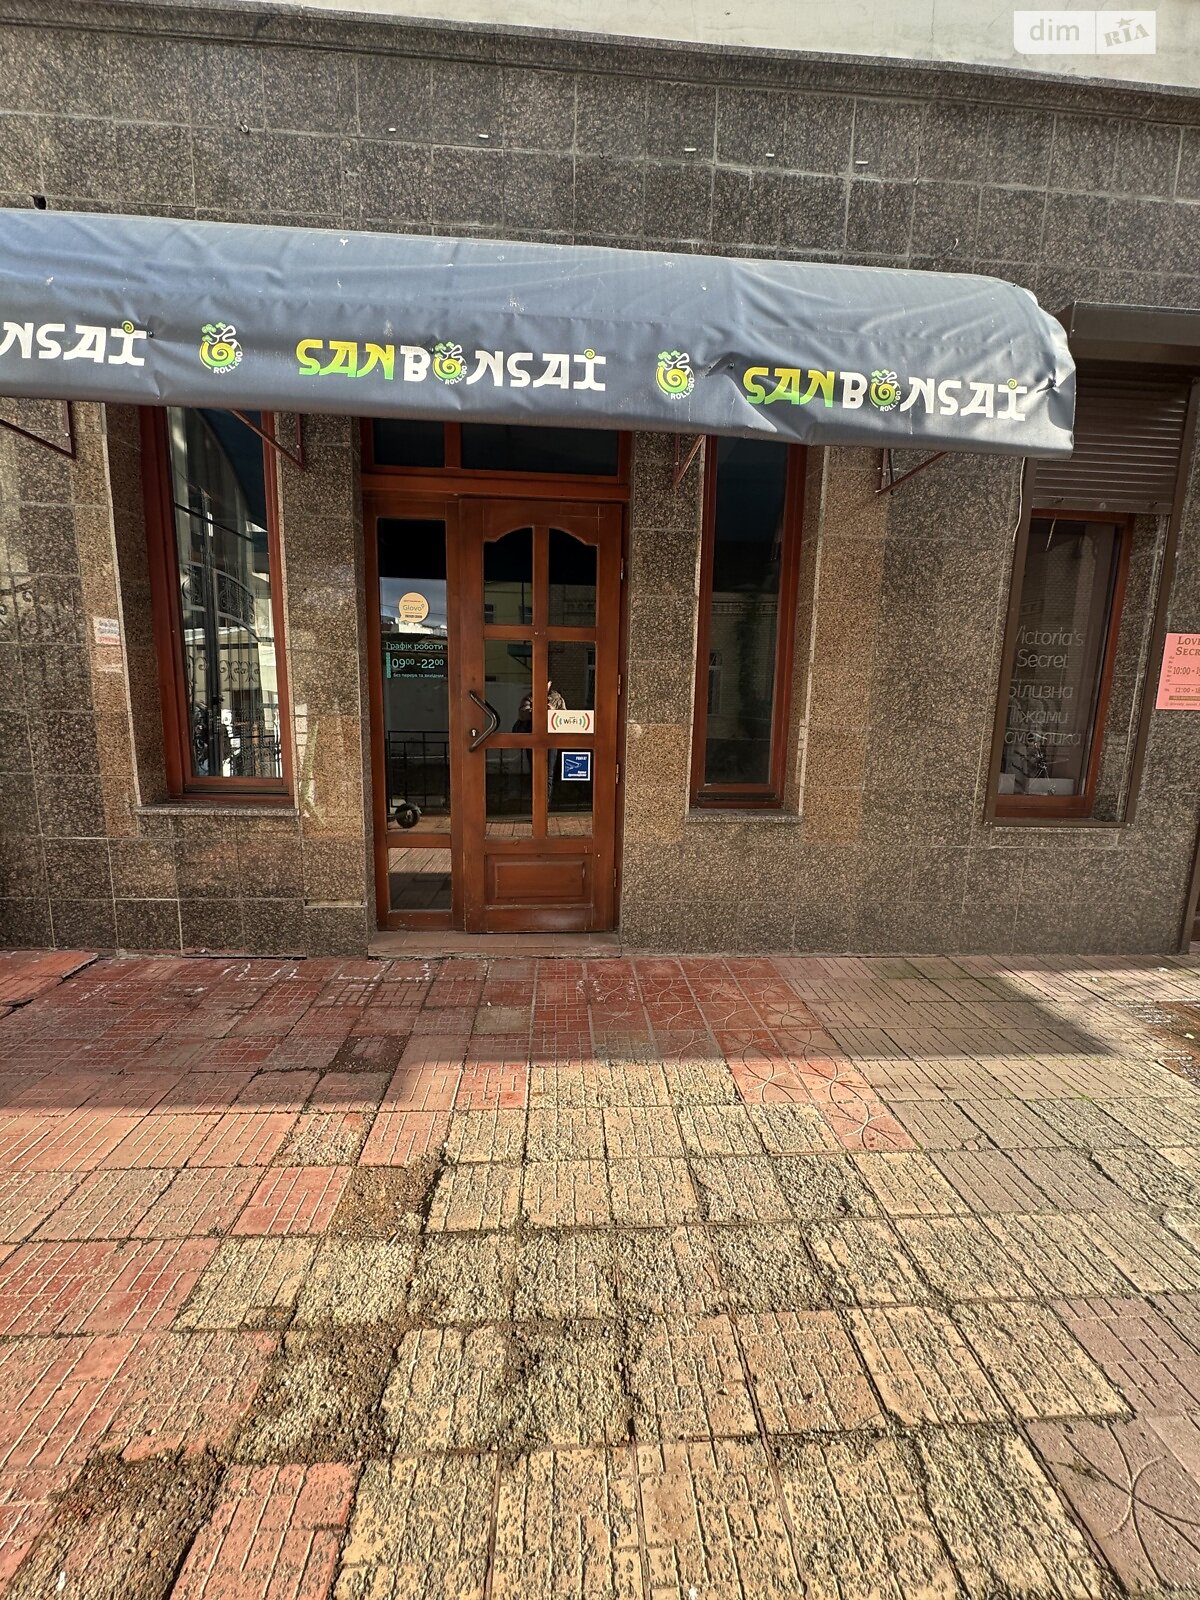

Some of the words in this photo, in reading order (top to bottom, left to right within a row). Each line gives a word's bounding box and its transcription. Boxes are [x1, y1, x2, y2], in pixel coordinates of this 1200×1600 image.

[213, 351, 243, 374] ROLL2GO
[403, 604, 423, 612] Glovo
[386, 642, 412, 651] Графік
[414, 643, 443, 651] роботи
[1017, 649, 1069, 668] Secret
